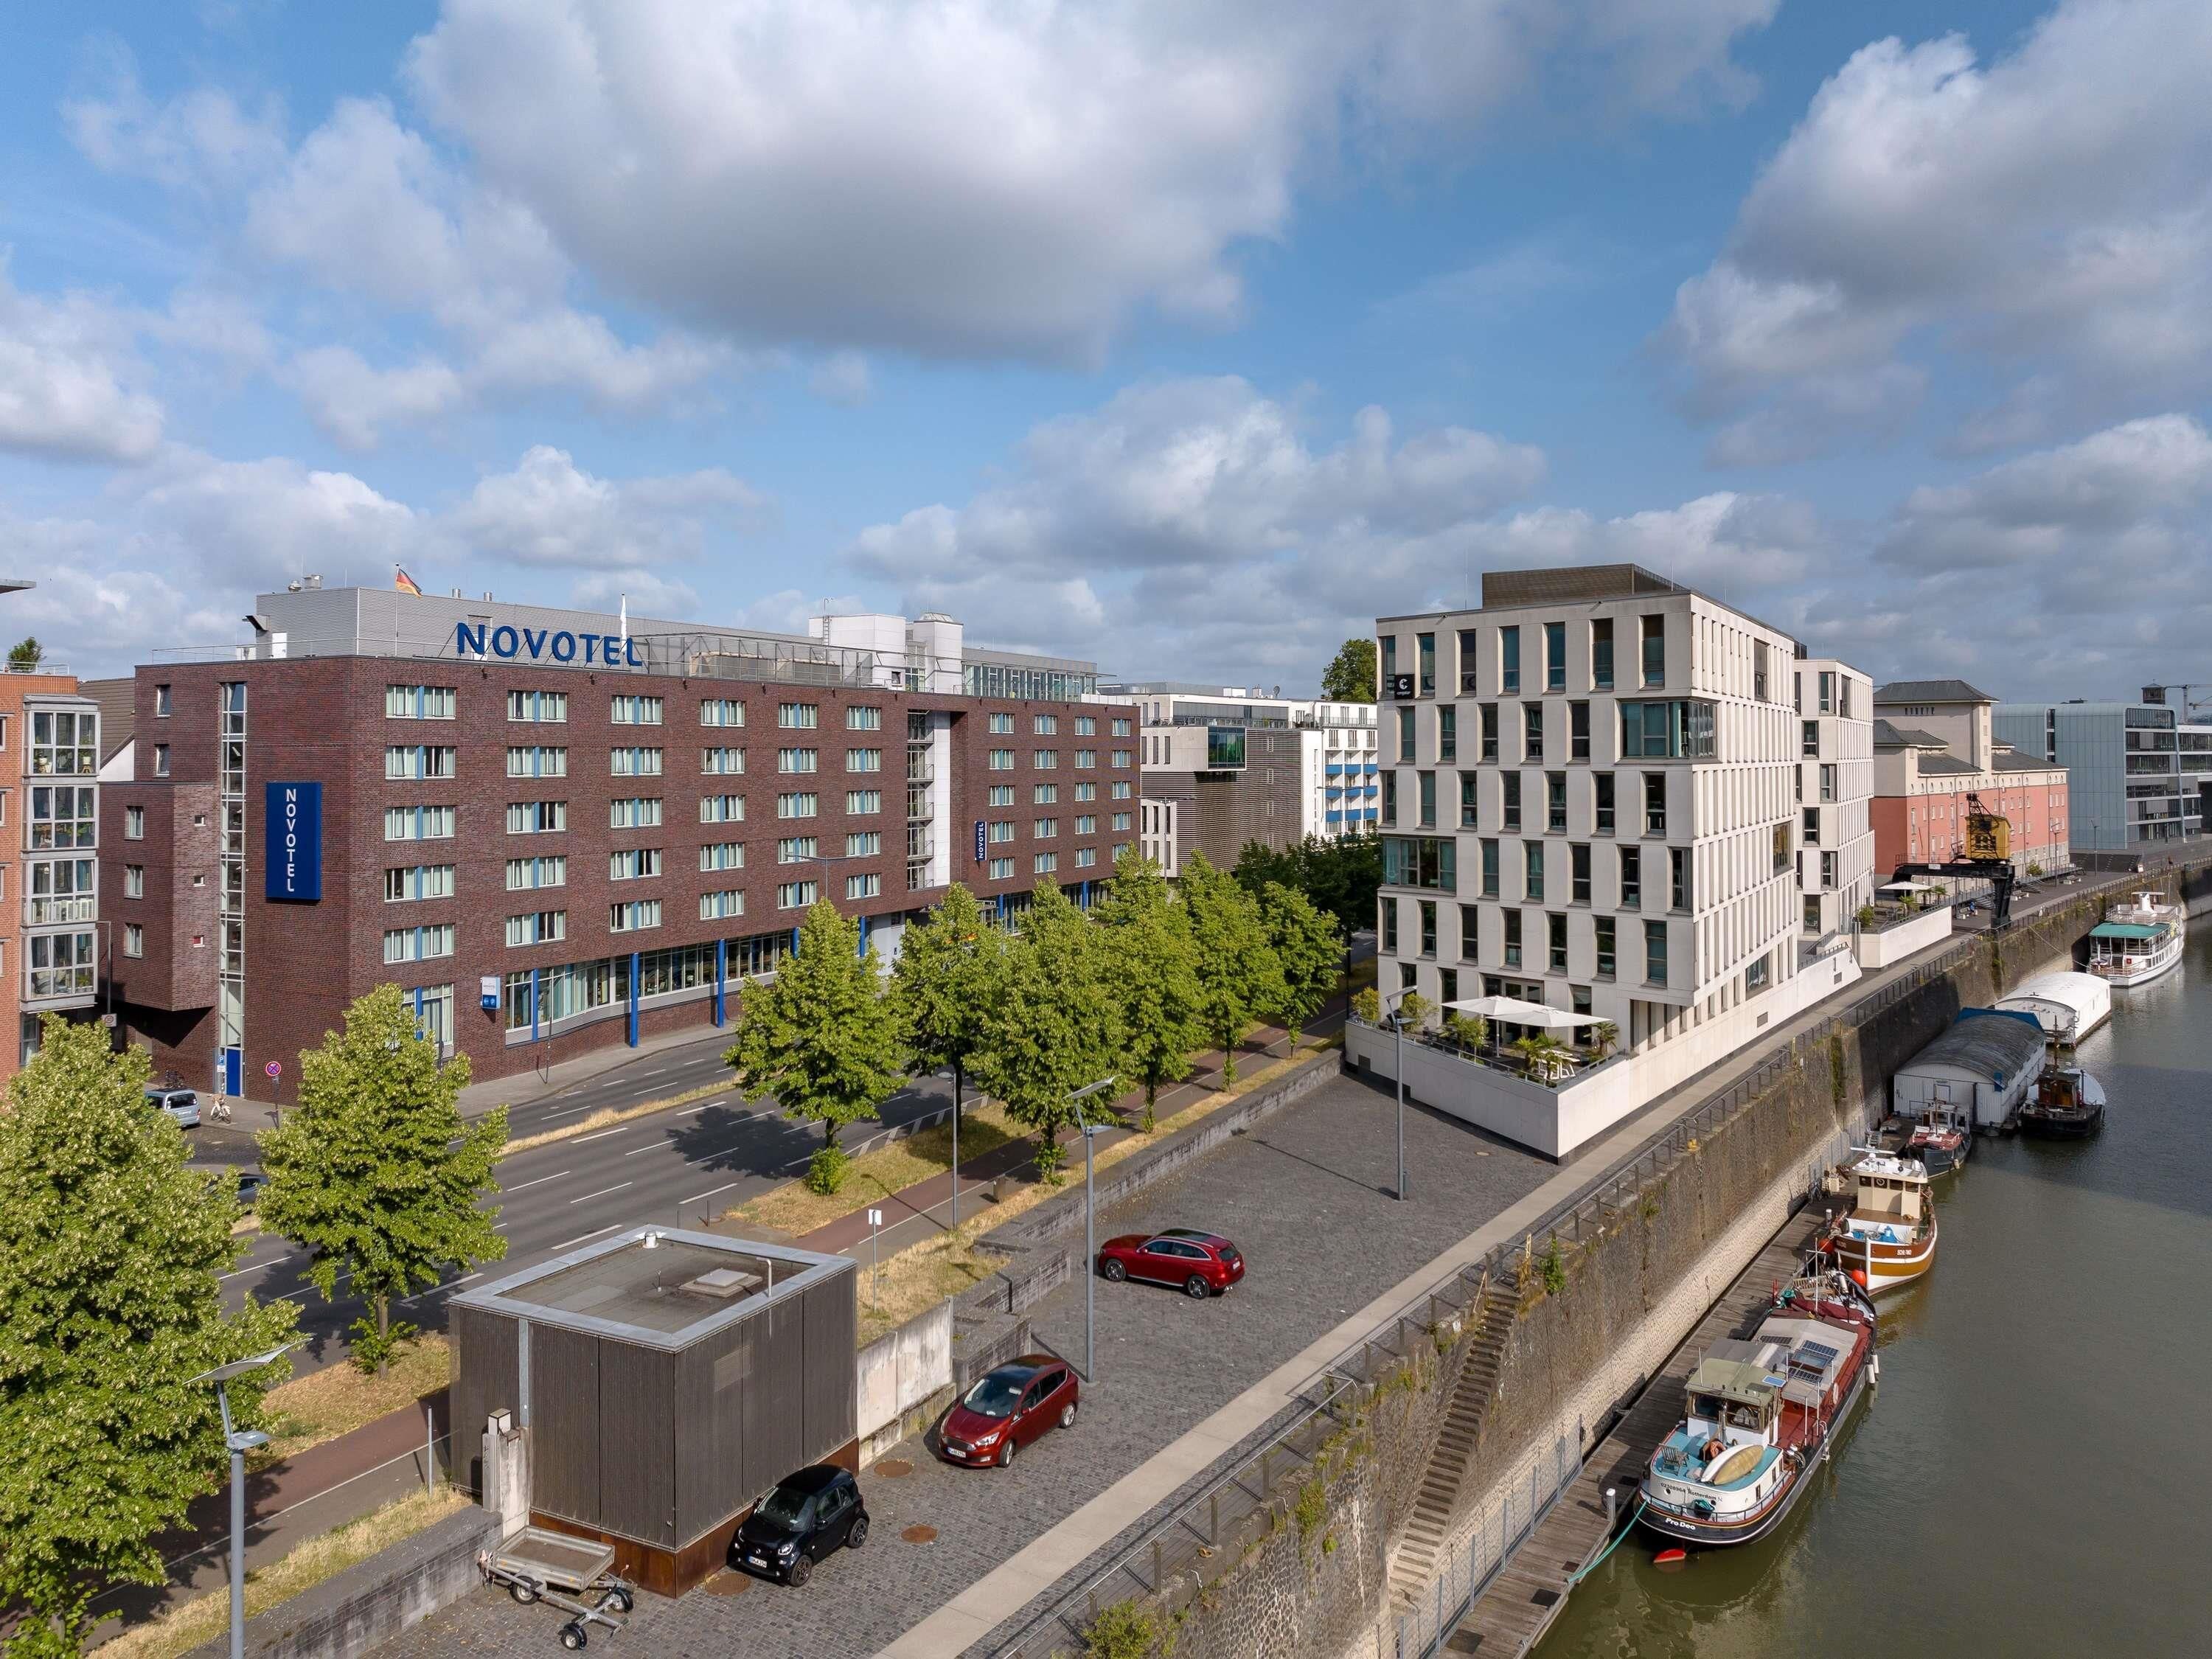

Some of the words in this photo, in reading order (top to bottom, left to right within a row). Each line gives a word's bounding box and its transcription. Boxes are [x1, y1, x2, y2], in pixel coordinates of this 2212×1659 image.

[457, 622, 643, 667] NOVOTEL
[286, 788, 296, 892] NOVOTEL
[1687, 1487, 1717, 1500] Rotterdam
[1665, 1517, 1679, 1526] Pro
[1680, 1521, 1696, 1531] Deo
